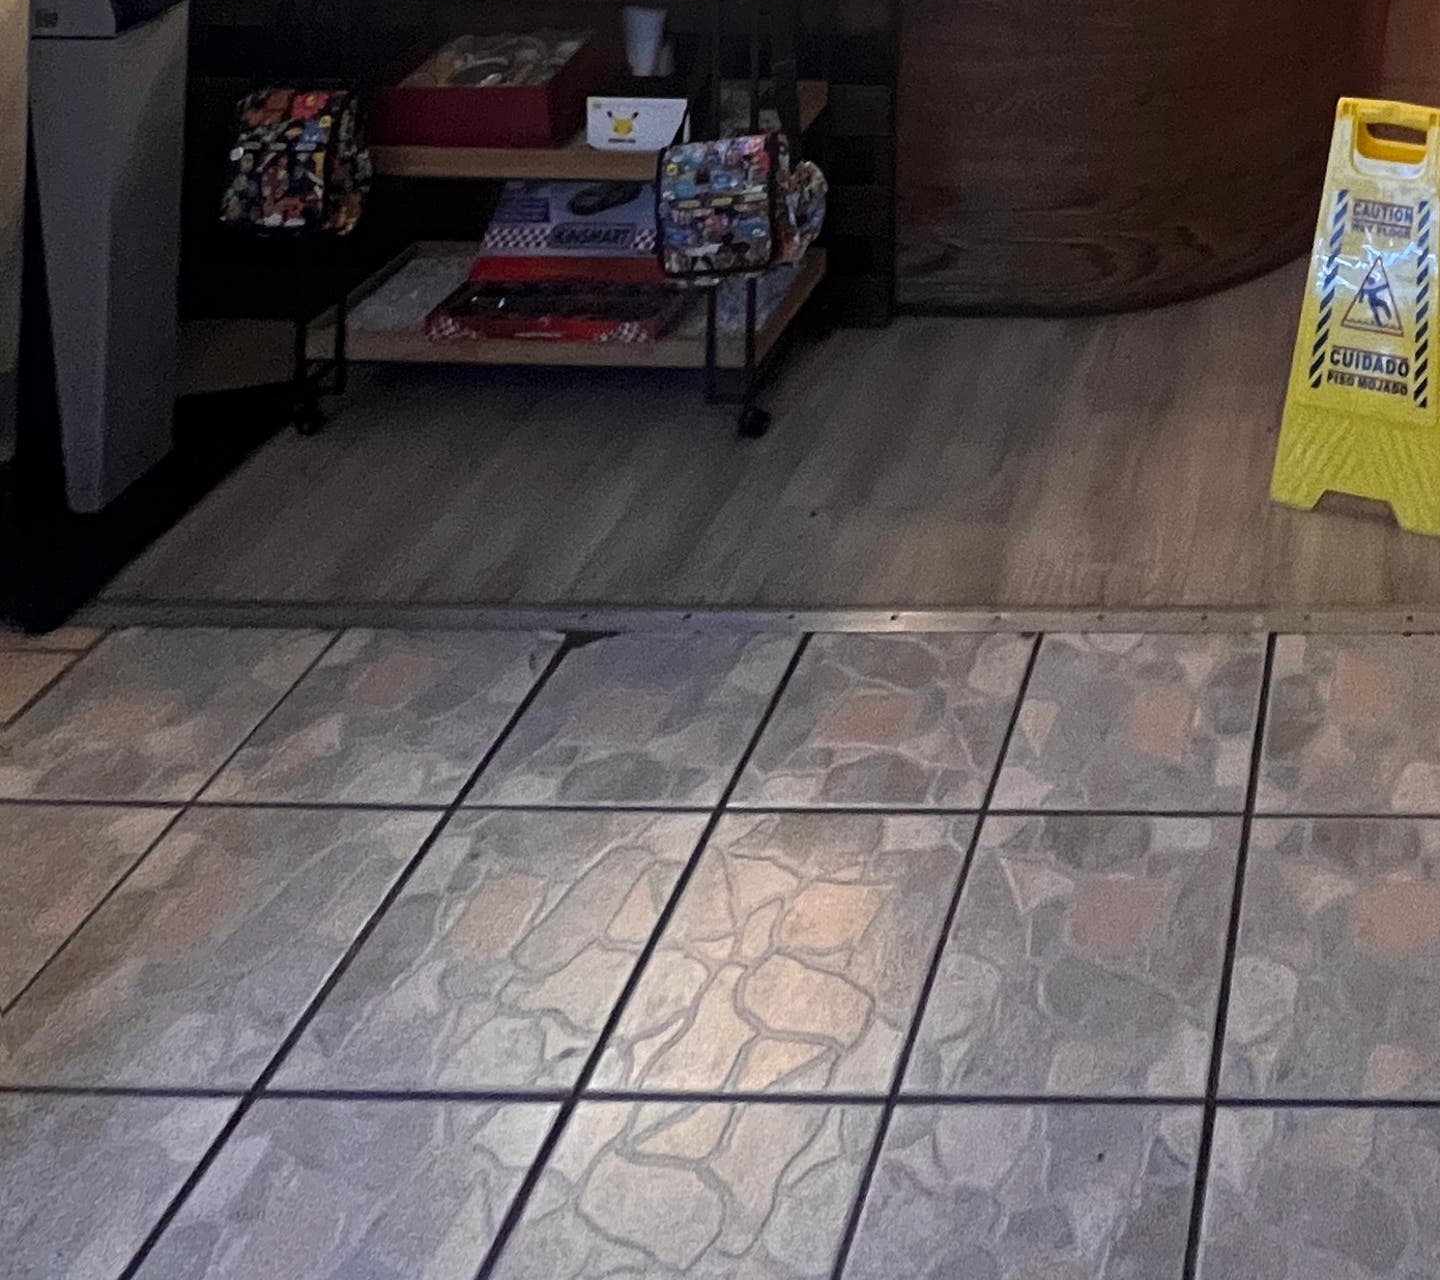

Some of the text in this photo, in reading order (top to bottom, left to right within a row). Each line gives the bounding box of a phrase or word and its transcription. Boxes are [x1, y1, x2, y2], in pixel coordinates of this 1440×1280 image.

[1352, 202, 1413, 224] CAUTION
[1330, 349, 1409, 378] CUIDADO
[1327, 370, 1408, 396] PISO MOJADO
